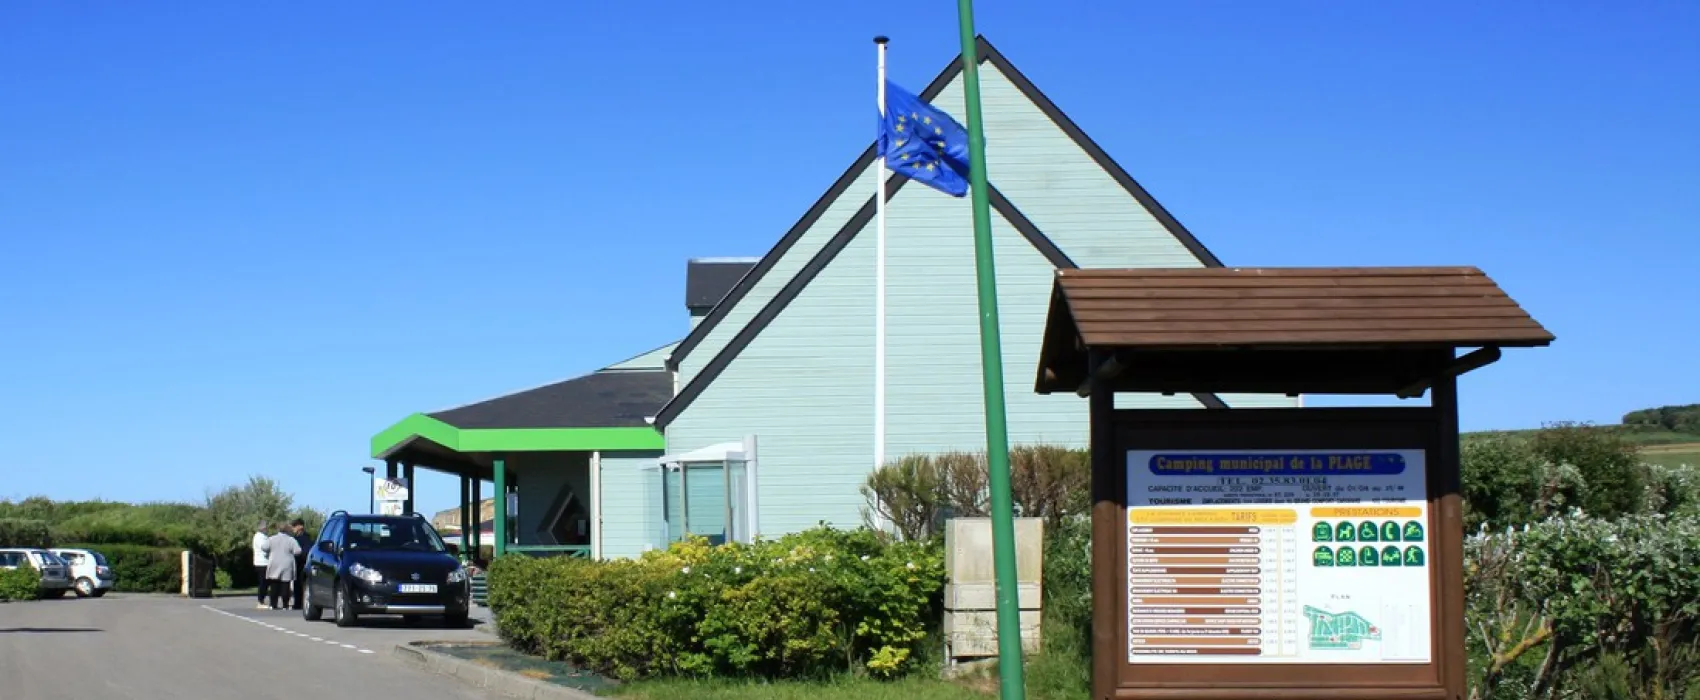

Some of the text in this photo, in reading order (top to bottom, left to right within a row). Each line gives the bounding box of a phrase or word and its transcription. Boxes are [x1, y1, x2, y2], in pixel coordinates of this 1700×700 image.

[1157, 456, 1373, 472] Camping municipal de la PLAGE
[1231, 511, 1257, 521] TARIFS
[1334, 507, 1400, 516] PRESTATIONS
